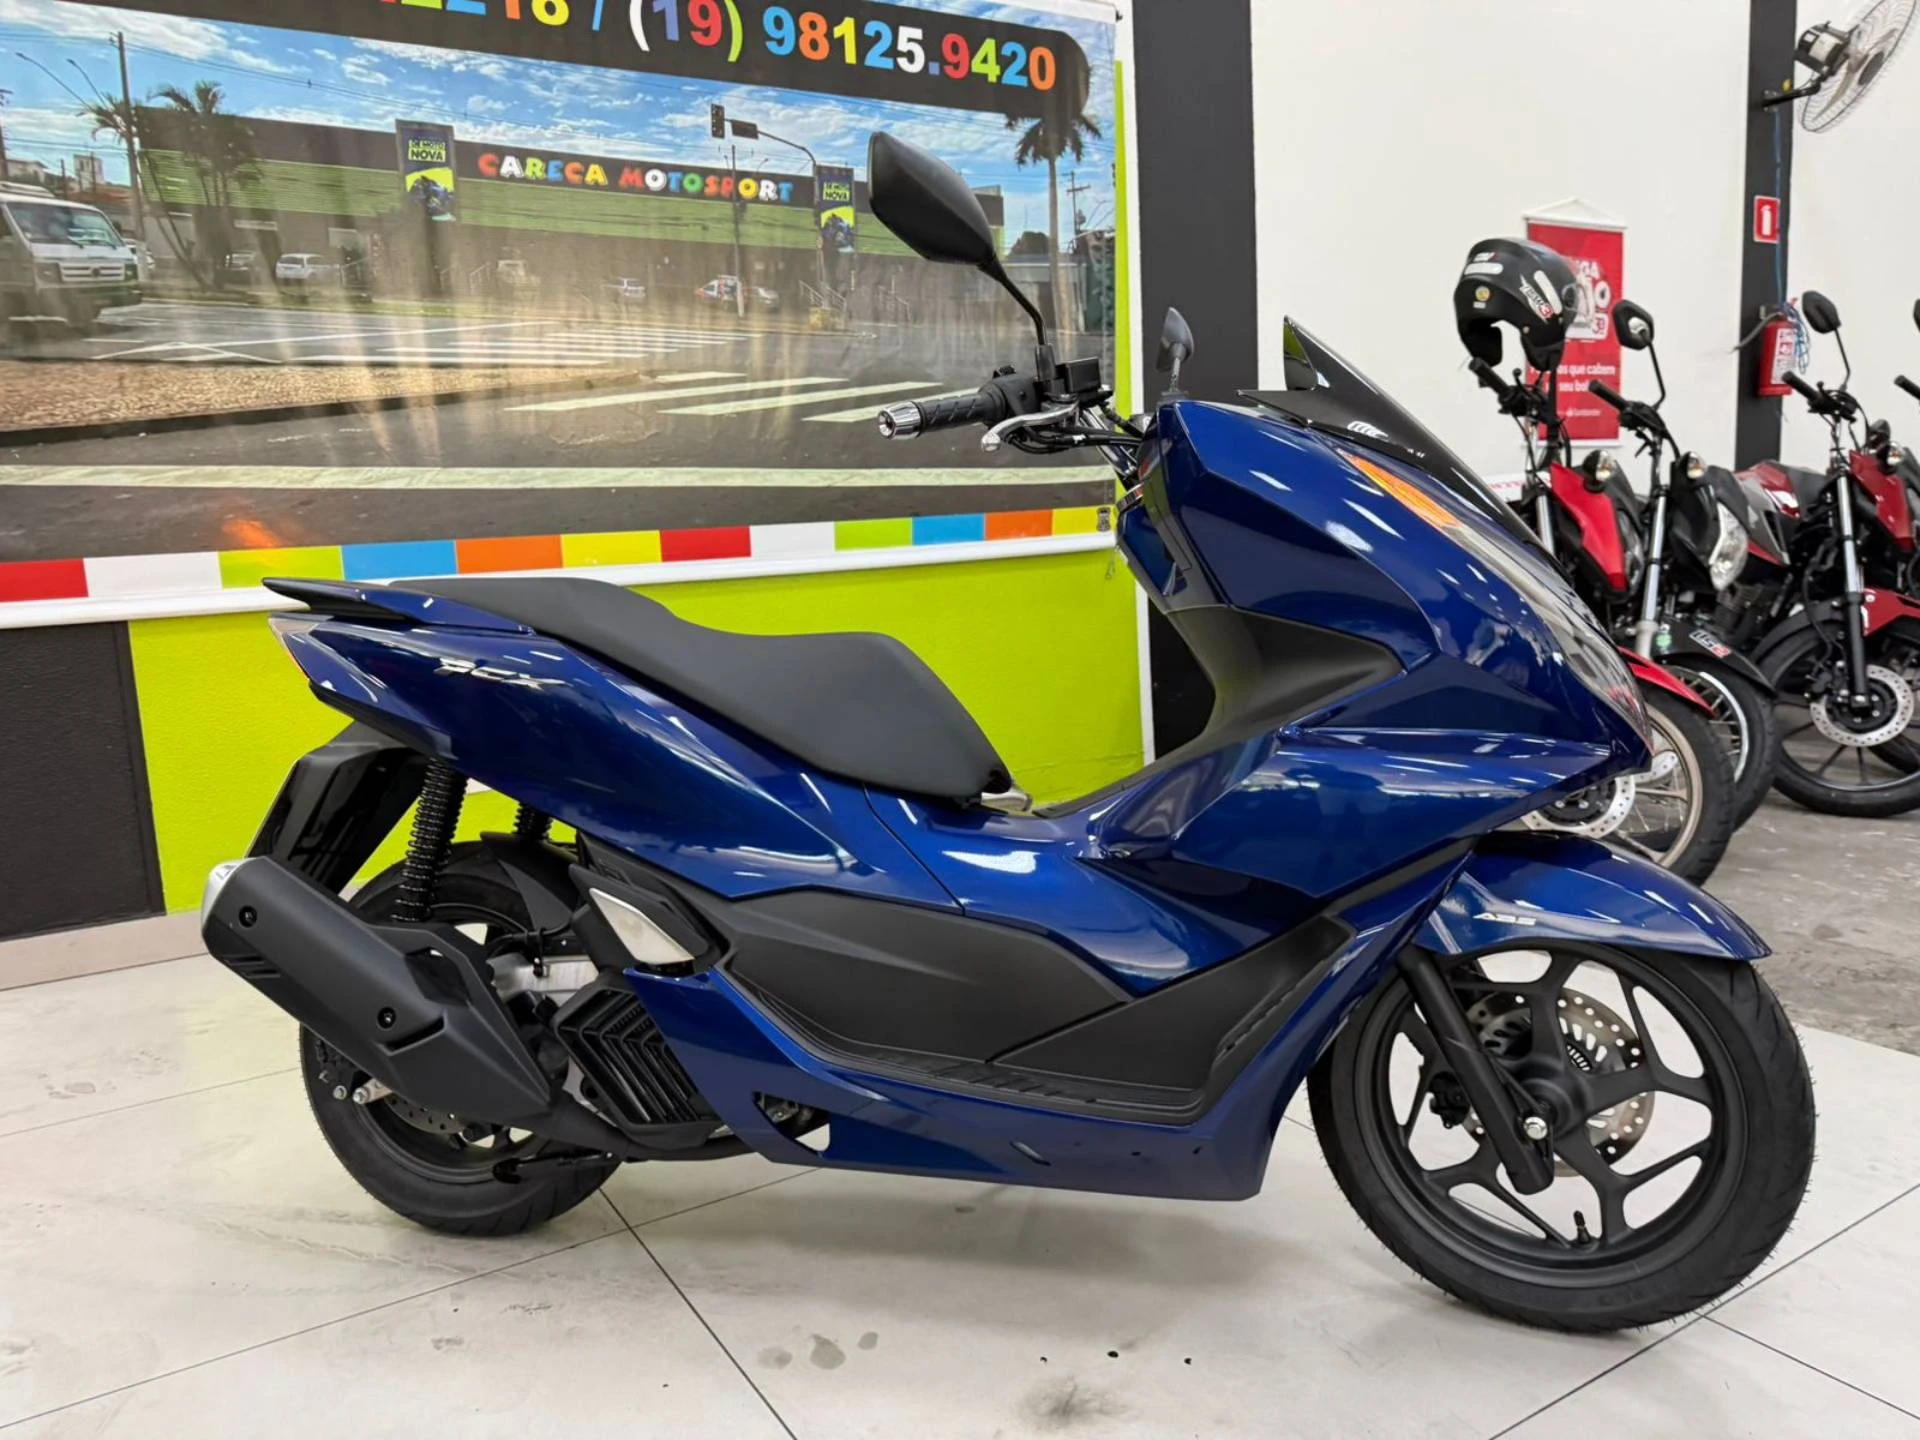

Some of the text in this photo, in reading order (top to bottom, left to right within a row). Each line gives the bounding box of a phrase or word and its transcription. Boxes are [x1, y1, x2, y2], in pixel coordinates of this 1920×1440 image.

[761, 6, 1057, 91] 98125.9420
[411, 149, 444, 161] NOVA
[477, 152, 794, 204] CARECA MOTOSPORT
